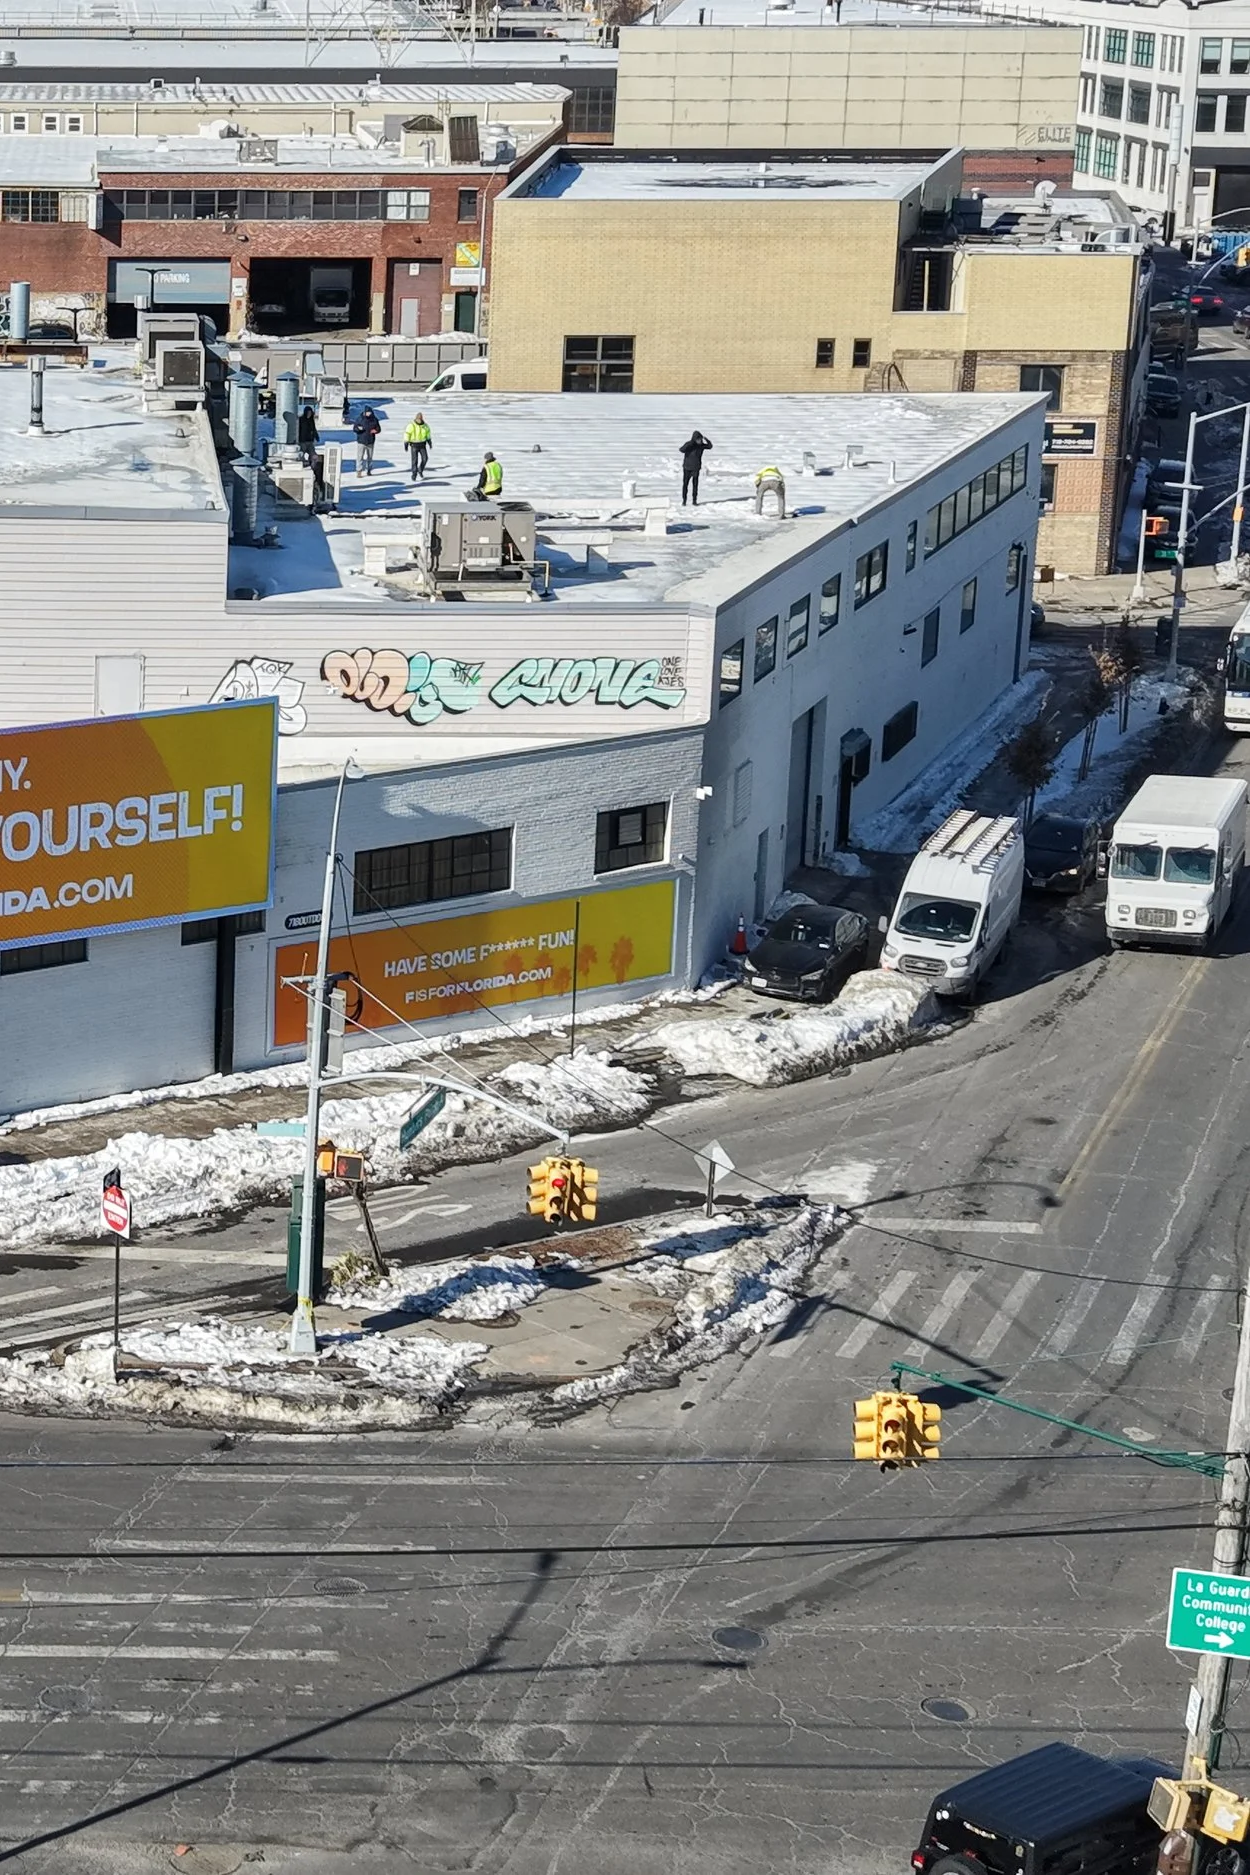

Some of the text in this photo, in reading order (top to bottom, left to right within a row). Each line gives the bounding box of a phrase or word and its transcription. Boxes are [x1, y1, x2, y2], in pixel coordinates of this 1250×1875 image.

[1038, 127, 1071, 138] ELITE
[160, 273, 190, 283] PARKING
[661, 656, 682, 666] ONE
[660, 667, 682, 677] LOVE
[384, 955, 428, 978] HAVE
[430, 947, 476, 969] SOME
[538, 928, 575, 951] FUN!
[1187, 1578, 1250, 1600] La Guard
[1195, 1613, 1246, 1634] College
